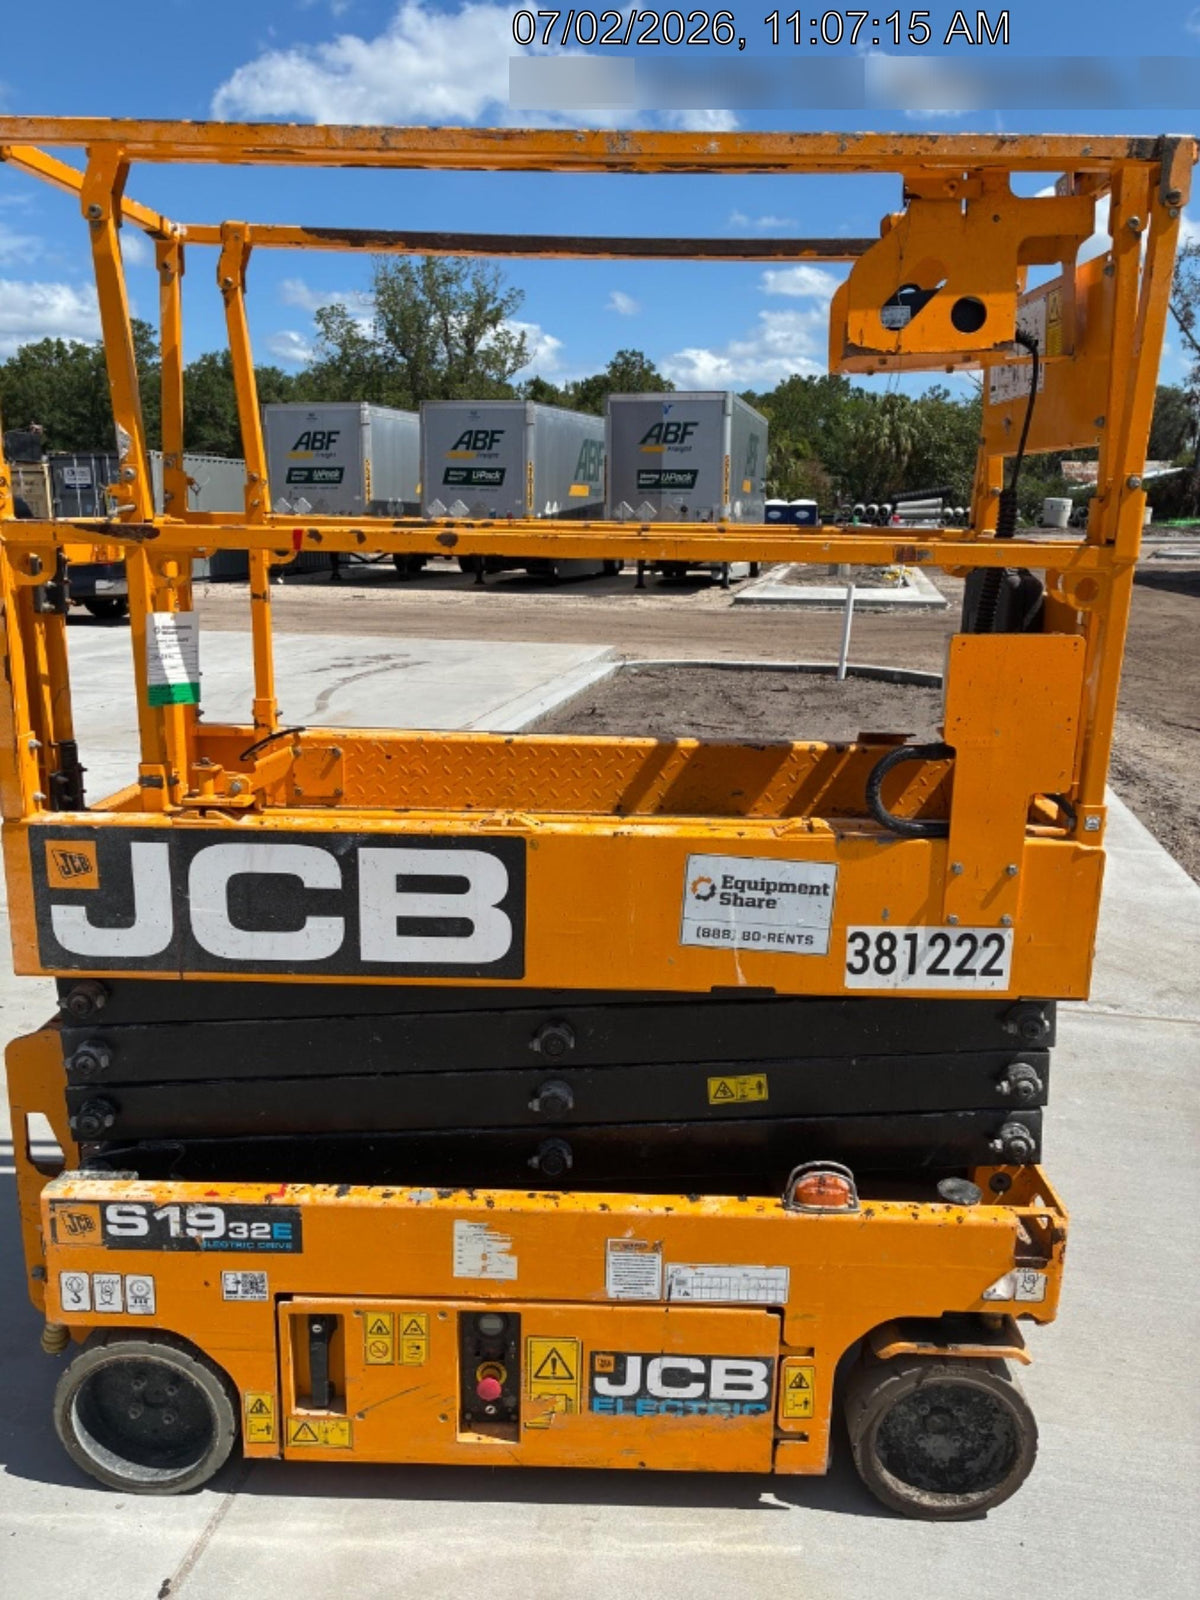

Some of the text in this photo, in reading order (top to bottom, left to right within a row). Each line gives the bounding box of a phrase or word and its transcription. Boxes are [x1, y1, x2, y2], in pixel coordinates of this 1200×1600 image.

[291, 430, 341, 451] ABF
[450, 429, 506, 451] ABF
[638, 421, 699, 445] ABF
[56, 851, 91, 876] JCB
[721, 874, 830, 897] Equipment
[50, 841, 513, 964] JCB
[719, 892, 777, 909] Share
[845, 931, 1006, 977] 381222
[594, 1355, 769, 1400] JCB
